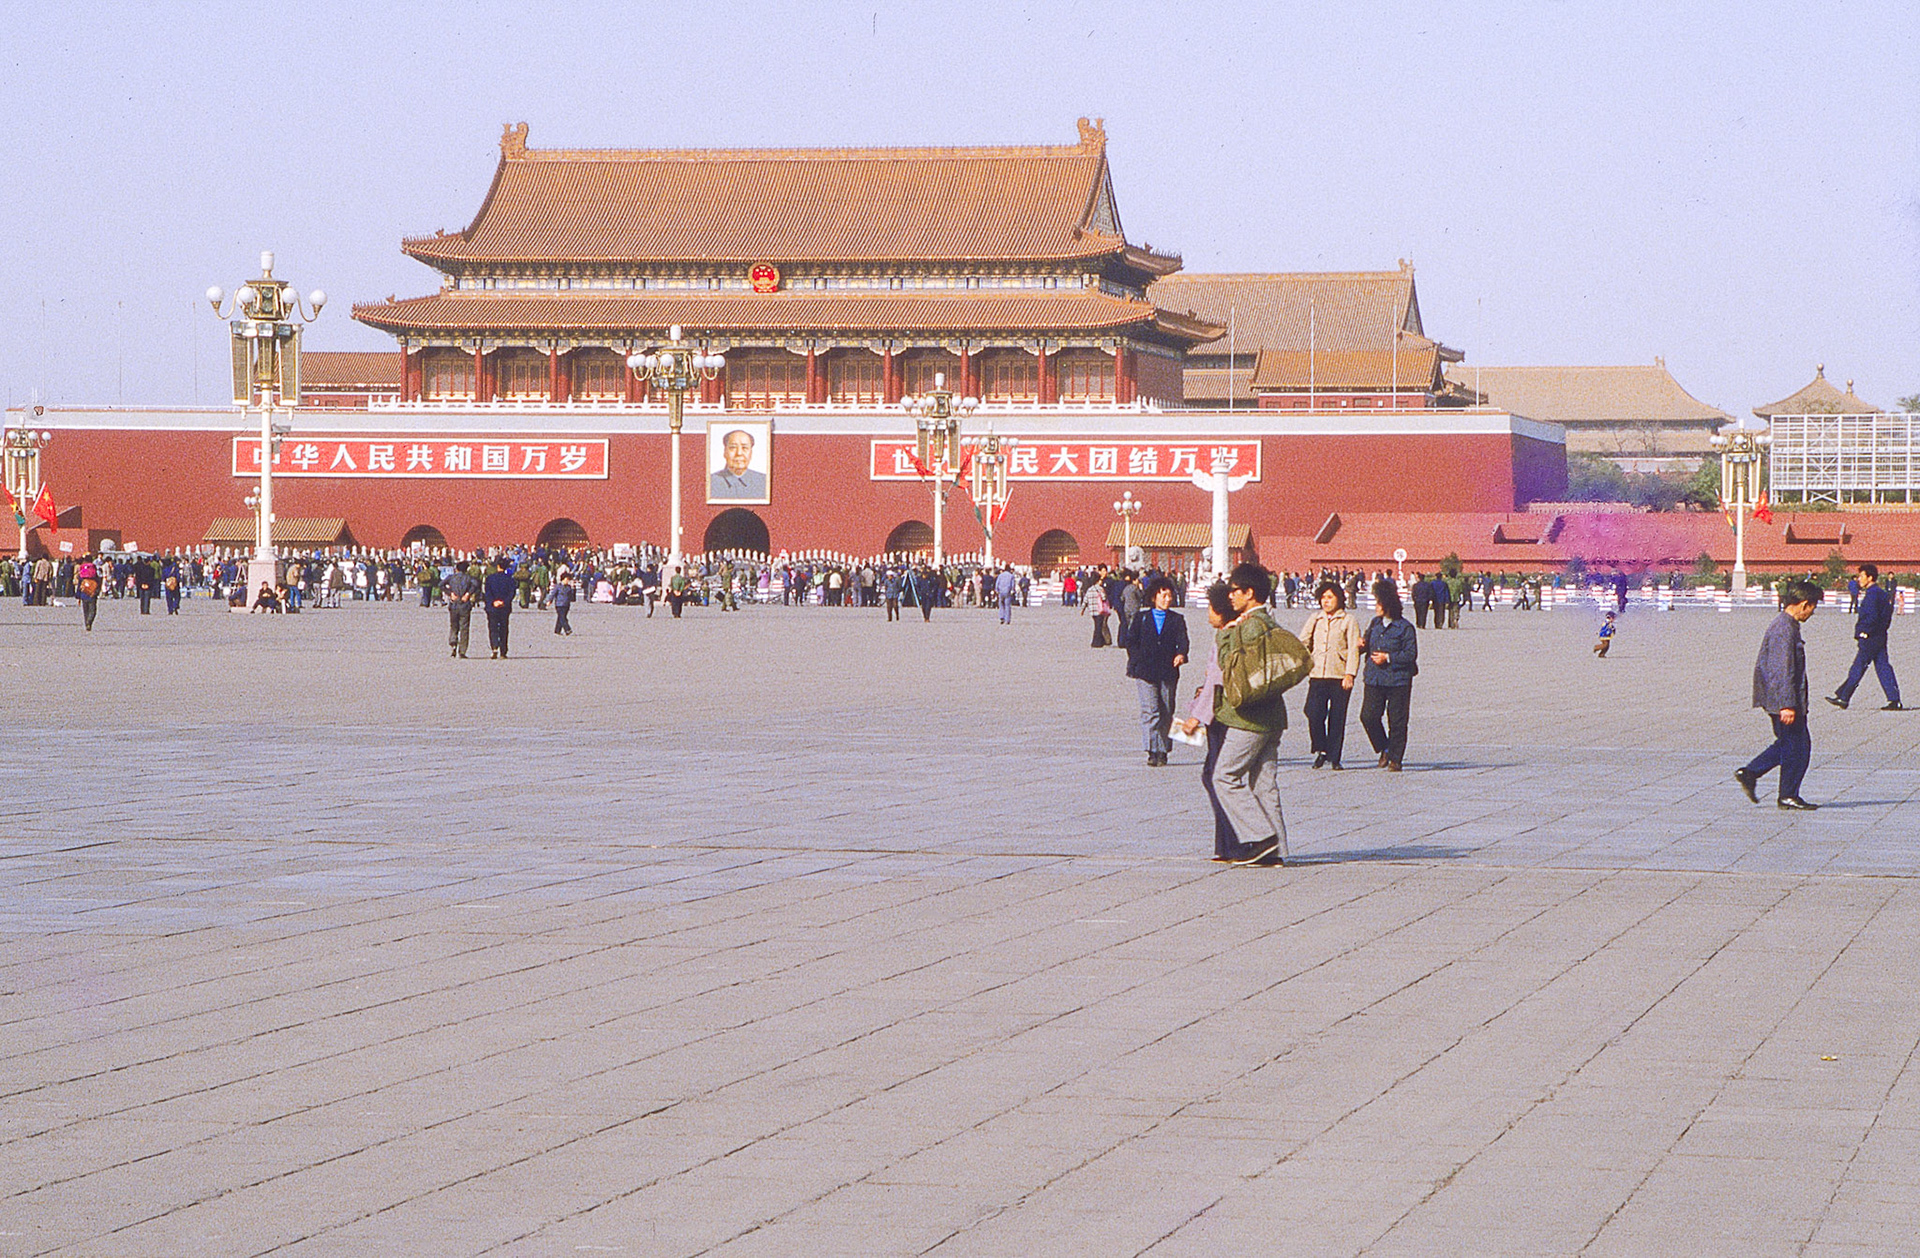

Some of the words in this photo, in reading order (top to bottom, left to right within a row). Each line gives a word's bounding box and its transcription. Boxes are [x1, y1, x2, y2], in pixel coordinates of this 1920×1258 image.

[892, 446, 1239, 474] 世民大团结万岁
